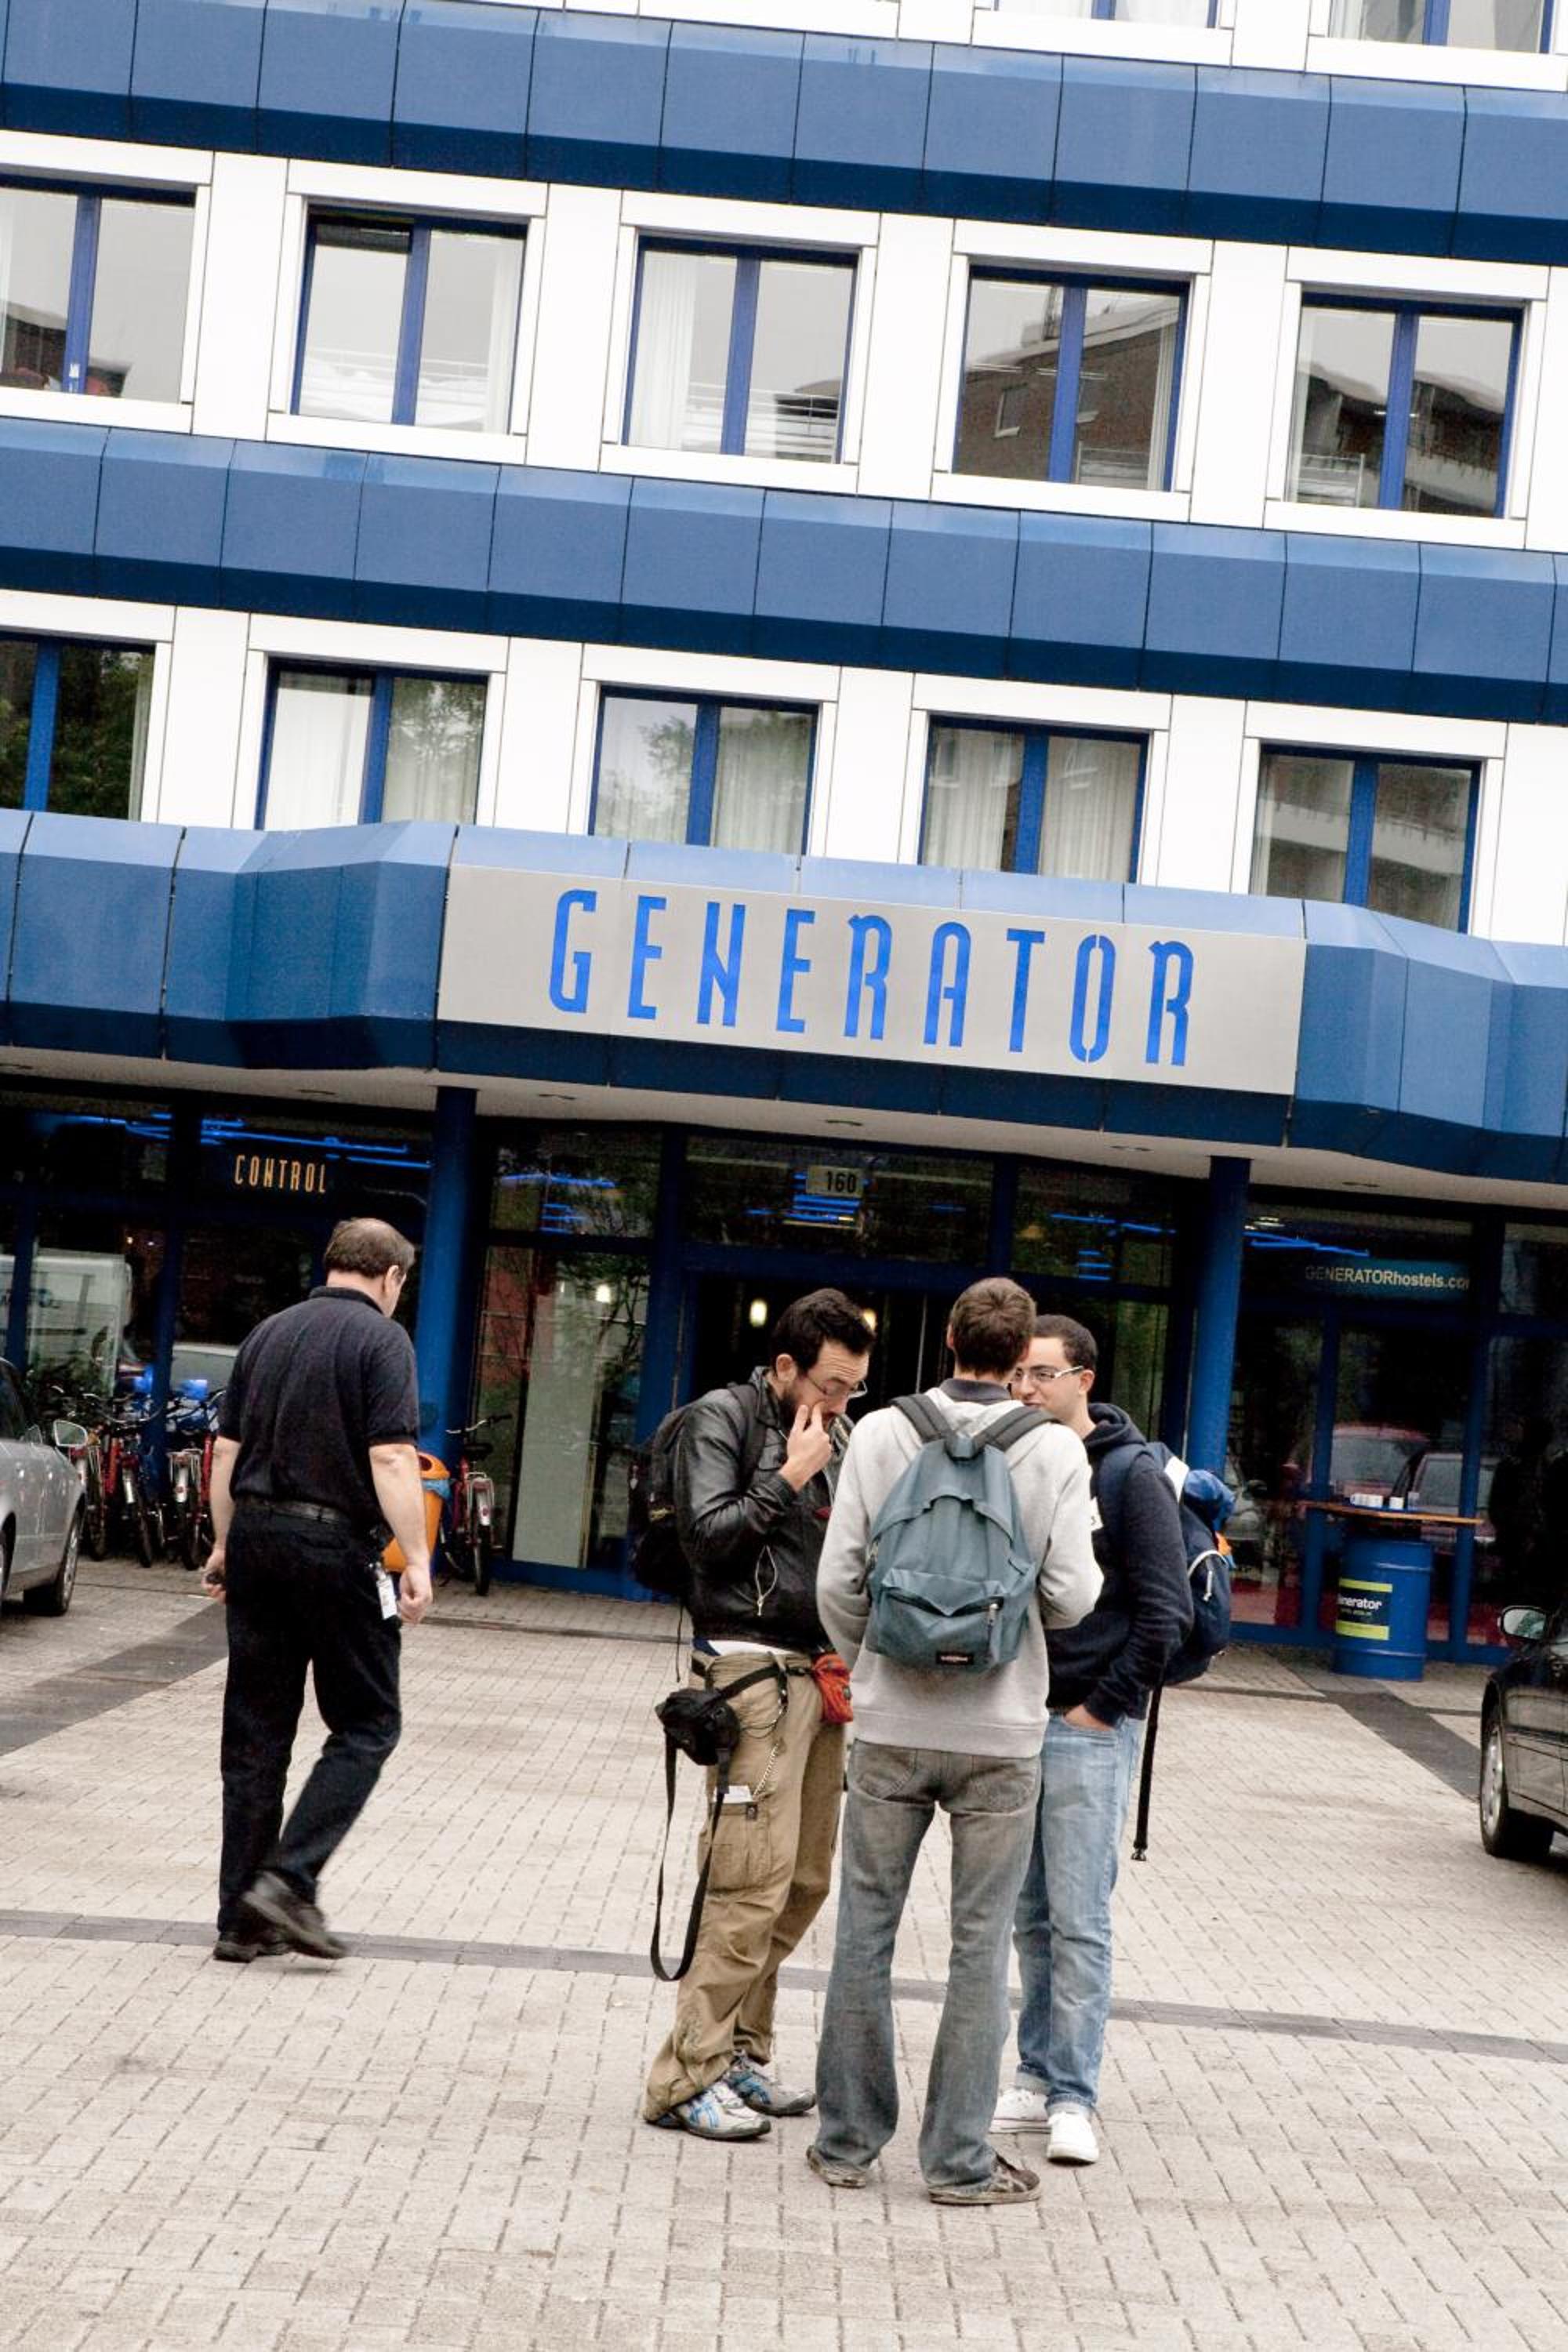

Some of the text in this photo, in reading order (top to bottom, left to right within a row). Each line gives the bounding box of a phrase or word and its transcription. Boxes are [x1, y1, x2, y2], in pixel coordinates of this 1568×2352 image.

[548, 889, 1194, 1067] GENERATOR
[234, 1154, 326, 1193] CONTROL
[827, 1171, 856, 1193] 160
